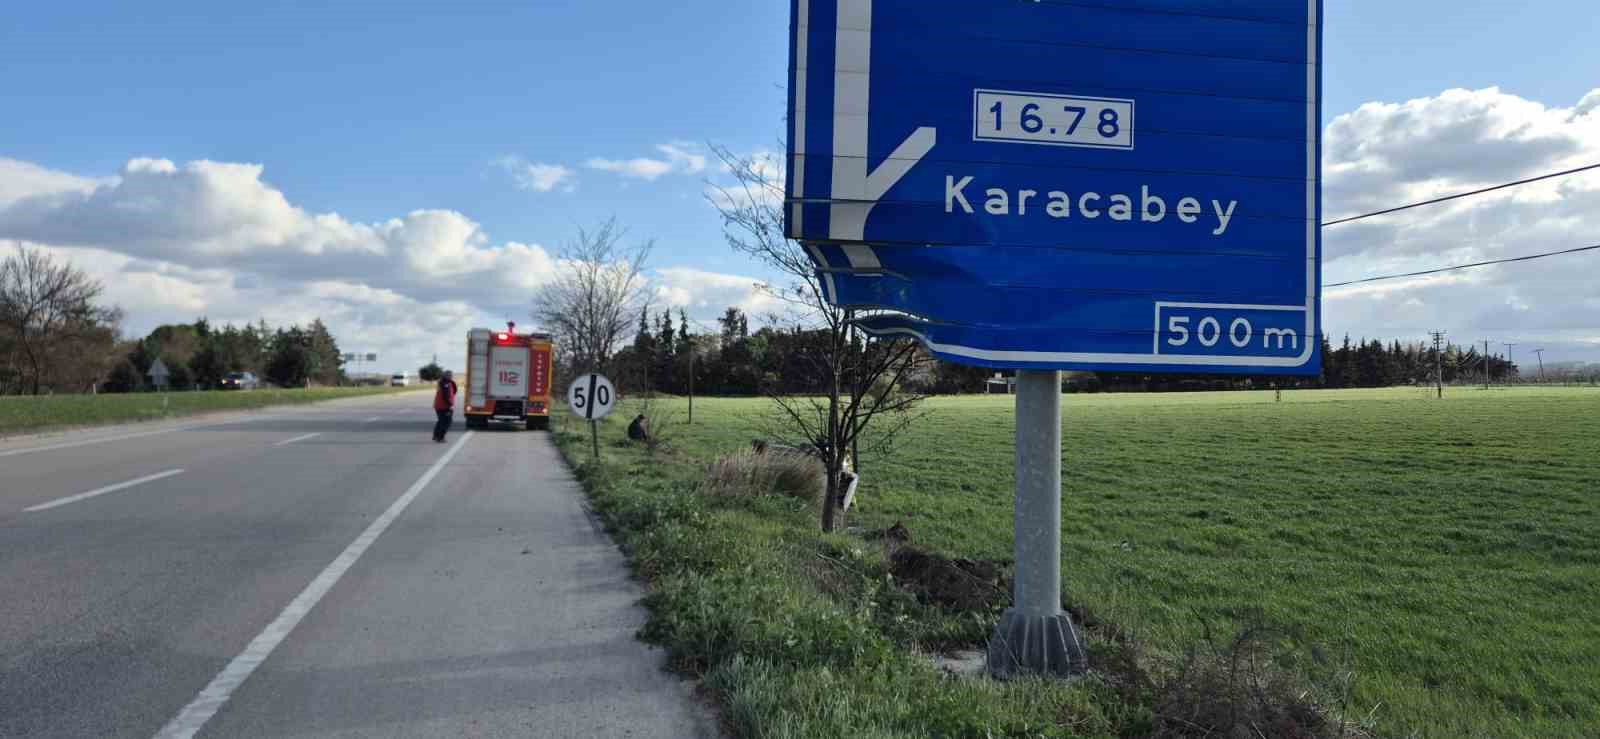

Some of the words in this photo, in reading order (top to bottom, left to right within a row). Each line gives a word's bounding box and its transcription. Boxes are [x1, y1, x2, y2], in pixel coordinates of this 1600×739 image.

[989, 102, 1120, 138] 16.78
[945, 175, 1237, 235] Karacabey
[499, 370, 521, 385] 112
